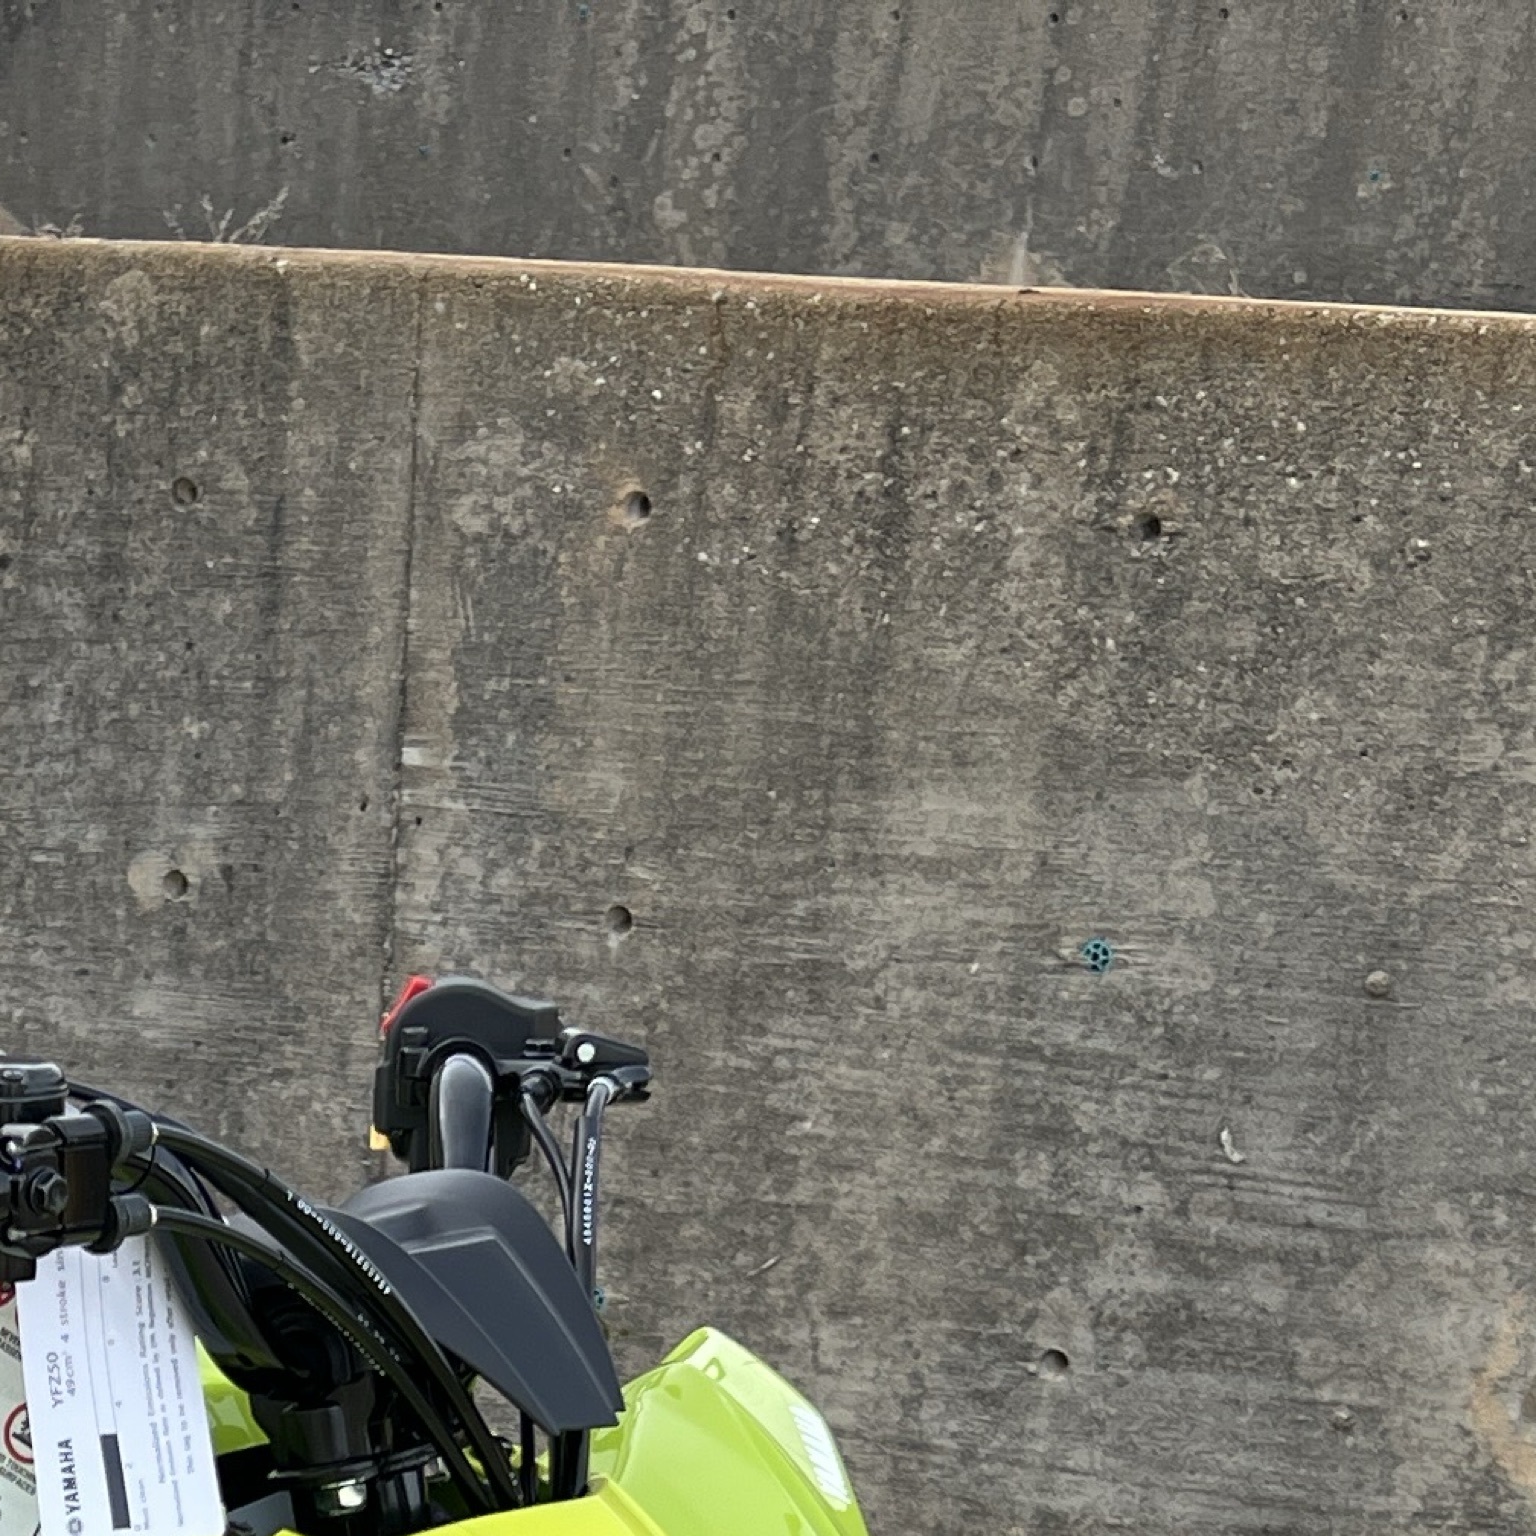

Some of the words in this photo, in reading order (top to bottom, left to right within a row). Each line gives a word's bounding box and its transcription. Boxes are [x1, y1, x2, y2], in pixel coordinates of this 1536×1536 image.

[53, 1278, 71, 1326] stroke
[44, 1350, 66, 1408] YFZ50
[55, 1436, 82, 1514] YAMAHA
